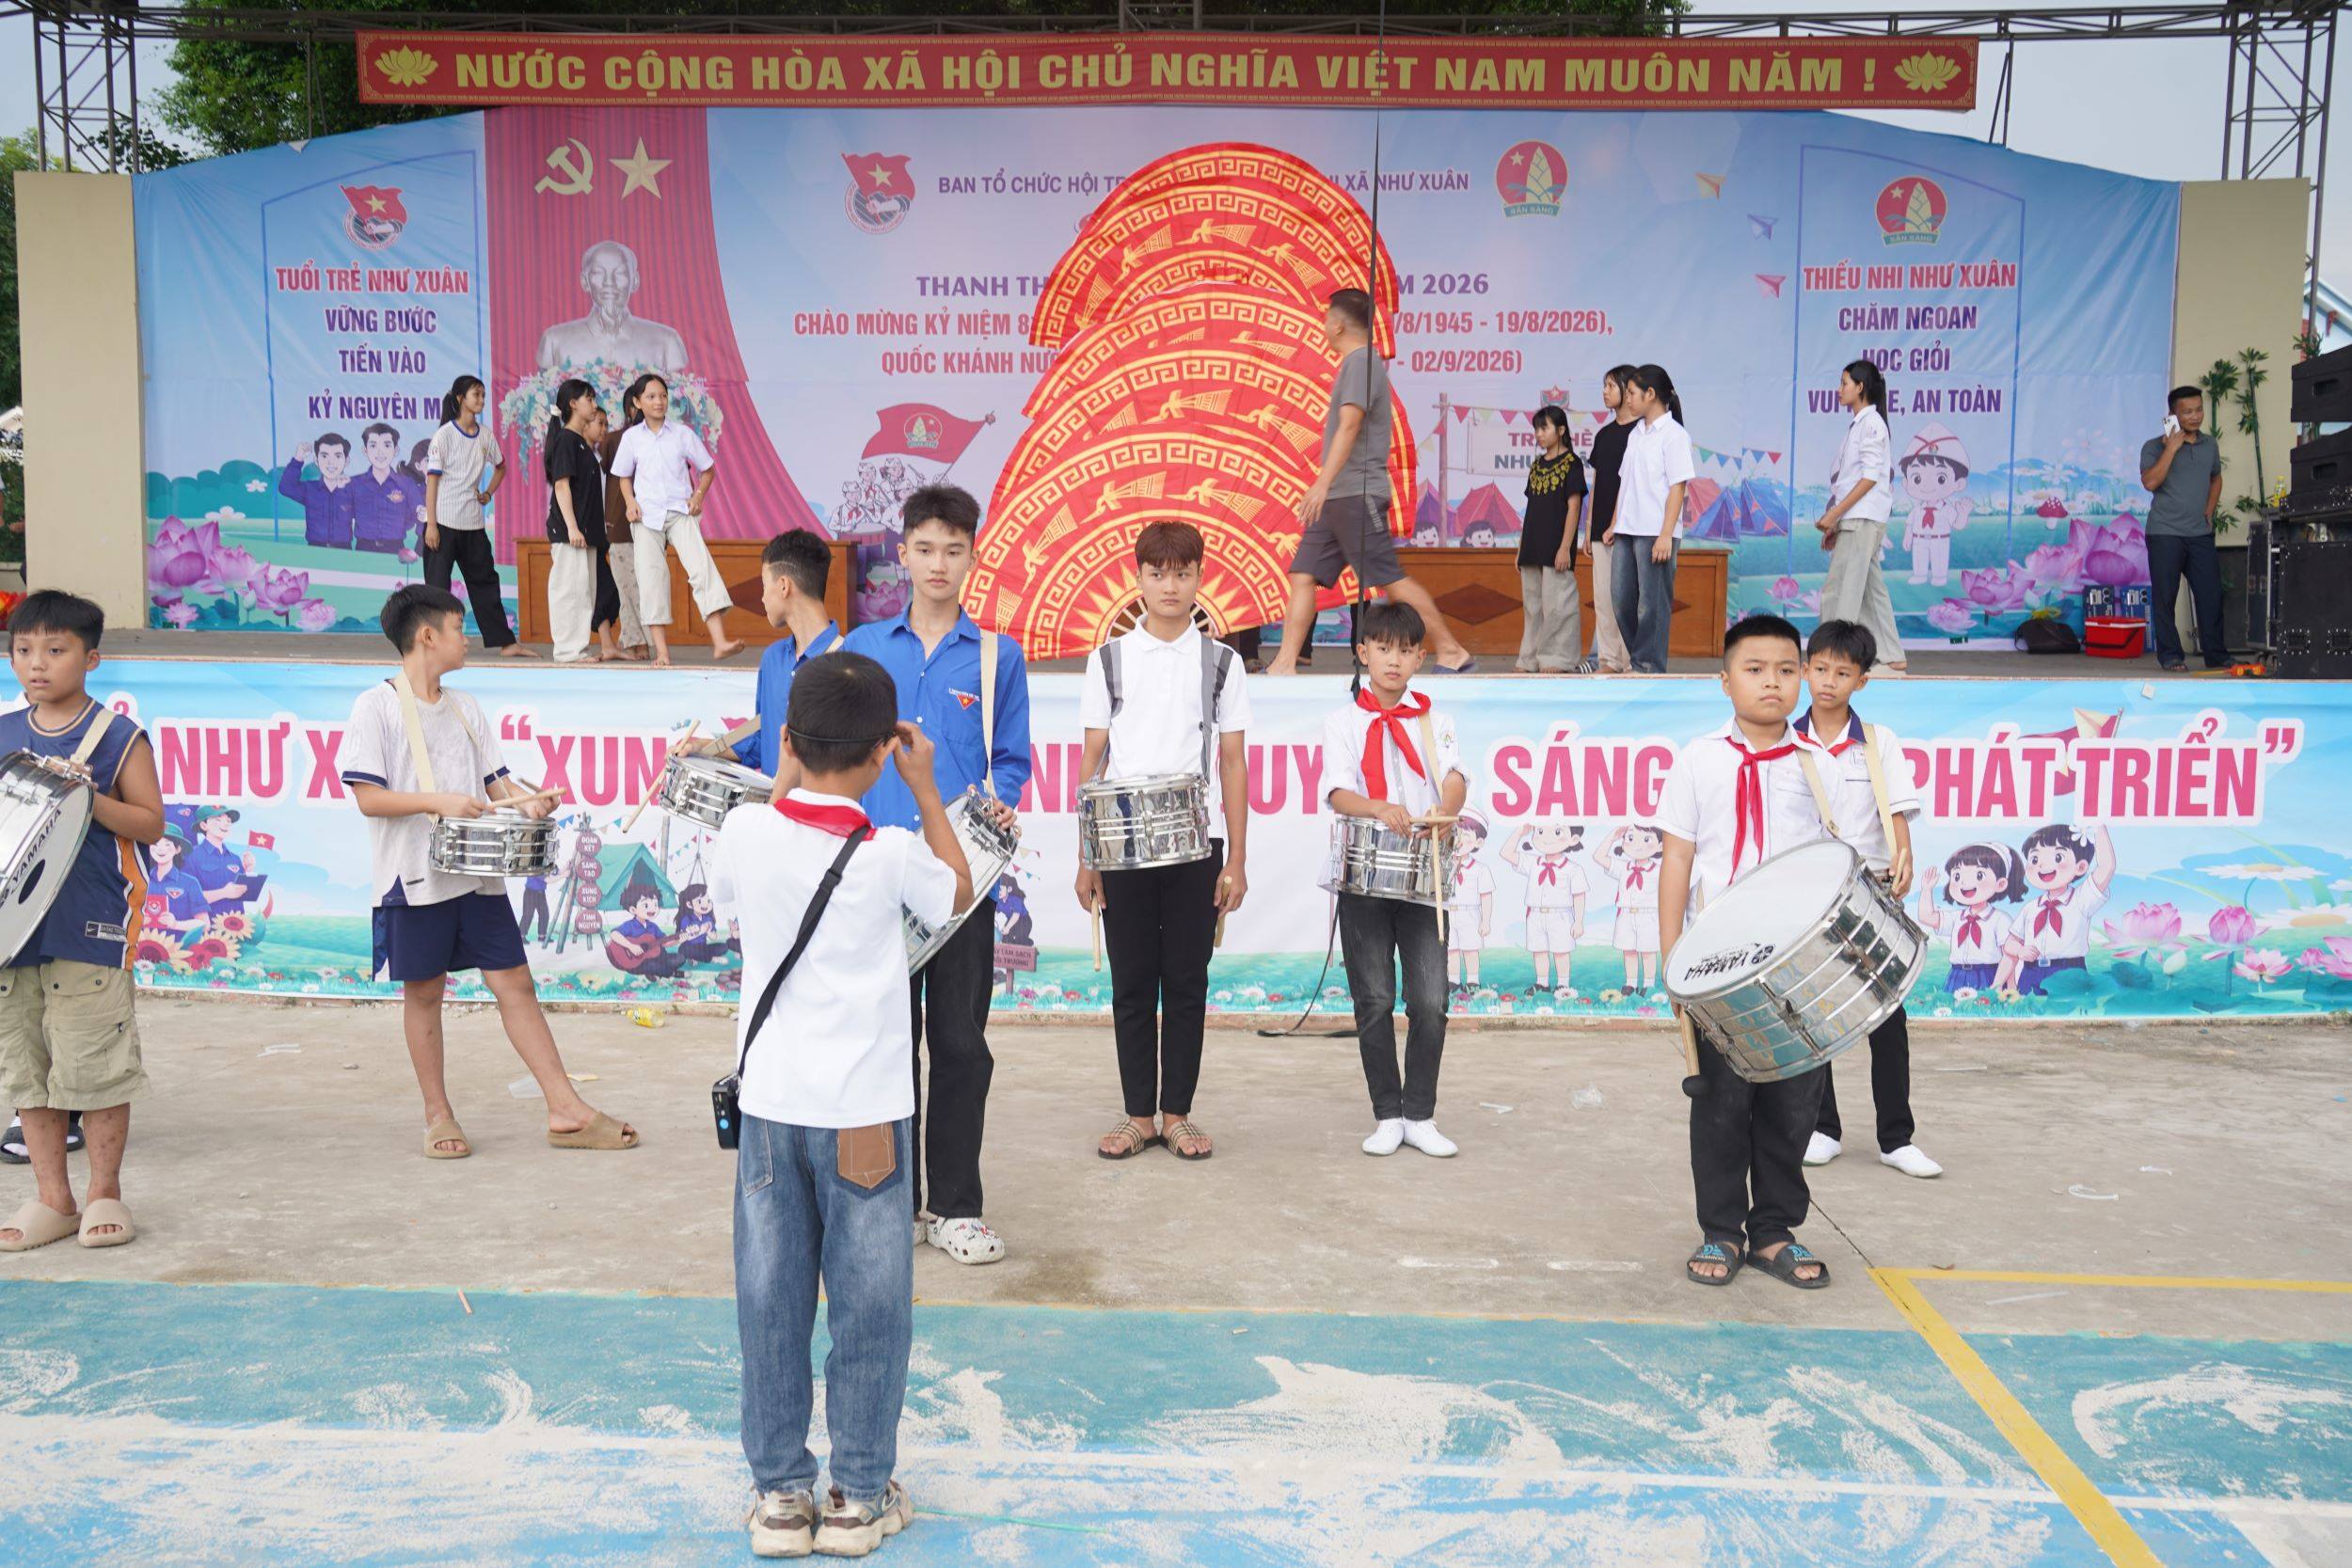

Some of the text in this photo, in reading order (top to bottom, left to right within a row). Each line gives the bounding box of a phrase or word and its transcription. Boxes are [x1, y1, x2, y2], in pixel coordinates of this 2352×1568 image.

[456, 50, 587, 89] NƯỚC
[604, 49, 735, 97] CỘNG
[753, 48, 848, 90] HÒA
[863, 50, 926, 90] XÃ
[943, 48, 1020, 97] HỘI
[1039, 42, 1133, 88] CHỦ
[1151, 48, 1299, 89] NGHĨA
[1316, 49, 1419, 97] VIỆT
[1435, 57, 1546, 91] NAM
[1564, 51, 1710, 92] MUÔN
[1728, 50, 1843, 92] NĂM
[939, 177, 976, 194] BAN
[981, 167, 1007, 194] TỔ
[1010, 172, 1062, 194] CHỨC
[1068, 171, 1098, 196] HỘI
[1345, 170, 1369, 191] XÃ
[1419, 169, 1470, 191] XUÂN
[276, 259, 469, 293] TUỔI TRẺ NHƯ XUÂN
[916, 276, 1009, 297] THANH
[1422, 273, 1489, 294] 2026
[1804, 258, 2016, 291] THIẾU NHI NHƯ XUÂN
[325, 305, 437, 334] VỮNG BƯỚC
[794, 309, 850, 336] CHÀO
[856, 309, 918, 336] MỪNG
[925, 307, 950, 336] KỶ
[958, 309, 1010, 341] NIỆM
[1393, 311, 1474, 334] /8/1945
[1495, 309, 1613, 336] 19/8/2026),
[1838, 302, 1978, 331] CHĂM NGOAN
[339, 342, 426, 373] TIẾN VÀO
[882, 344, 936, 375] QUỐC
[944, 345, 1013, 374] KHÁNH
[1411, 349, 1523, 373] 02/9/2026)
[1910, 340, 1950, 372] GIỎI
[309, 388, 333, 420] KỶ
[340, 392, 418, 420] NGUYÊN
[1912, 389, 1941, 413] AN
[1947, 384, 2002, 413] TOÀN
[159, 721, 290, 800] NHƯ
[501, 714, 698, 807] “XUN
[11, 807, 62, 884] YAMAHA
